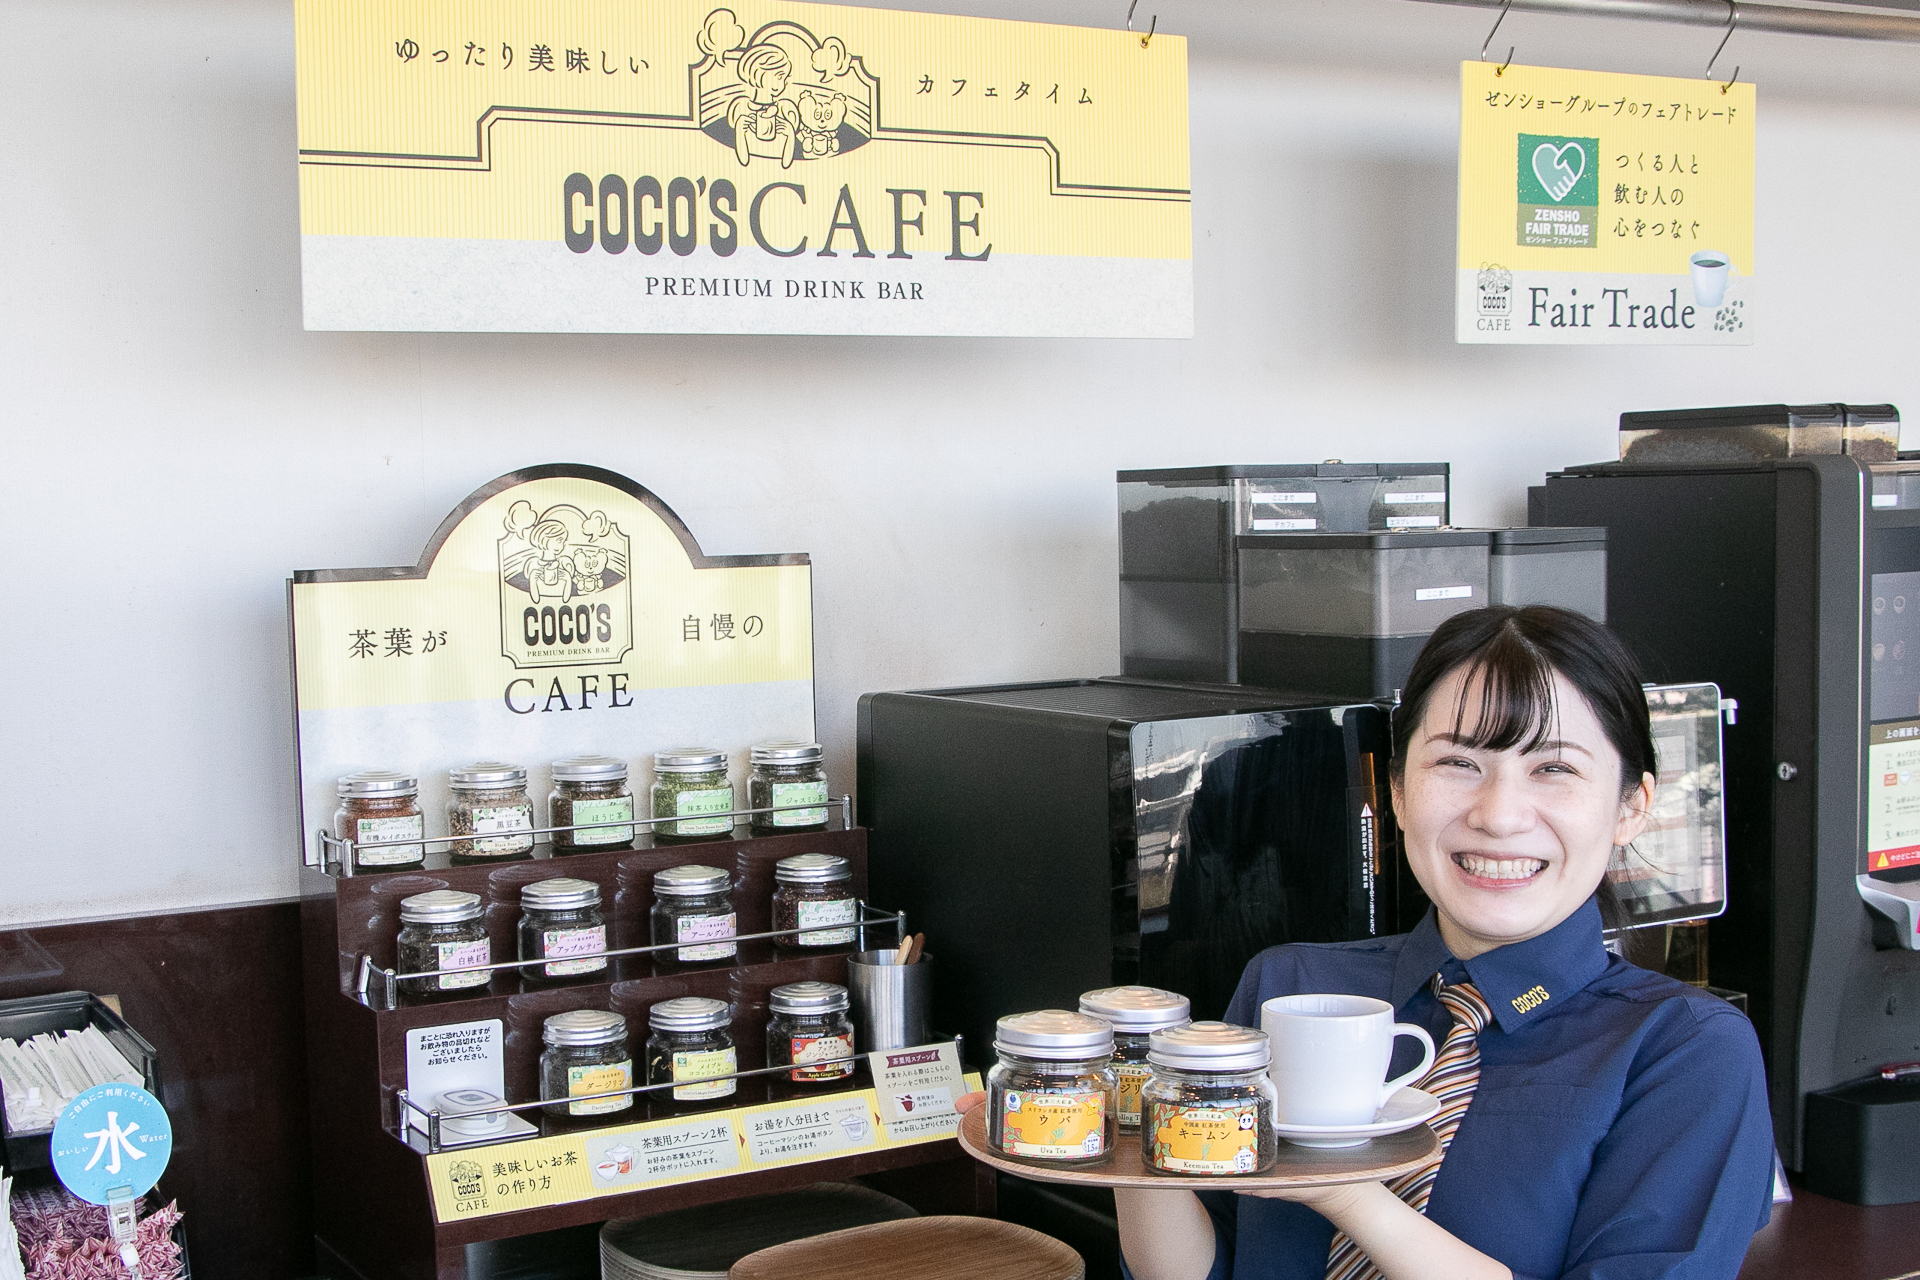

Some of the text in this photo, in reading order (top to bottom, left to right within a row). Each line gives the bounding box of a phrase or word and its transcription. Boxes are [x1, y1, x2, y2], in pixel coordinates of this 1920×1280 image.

[395, 38, 650, 75] ゆったり美味しい
[916, 74, 1094, 105] カフェタイム
[1485, 91, 1737, 125] ゼンショーグループのフェアトレード
[1615, 152, 1700, 175] つくる人と
[1614, 183, 1685, 206] 飲む人の
[564, 172, 993, 262] COCO'S CAFE
[1534, 208, 1581, 223] ZENSHO
[1525, 222, 1590, 237] FAIR TRADE
[1613, 217, 1701, 240] 心をつなぐ
[1525, 236, 1589, 246] ゼンショー フェアトレード
[645, 276, 925, 301] PREMIUM DRINK BAR
[1482, 296, 1507, 309] COCO'S
[1528, 287, 1697, 329] Fair Trade
[1476, 318, 1512, 331] CAFE
[1274, 520, 1296, 528] デカフェ
[523, 602, 612, 647] COCO'S
[682, 613, 764, 642] 自慢の
[348, 627, 448, 659] 茶葉が
[527, 649, 565, 657] PREMIUM
[567, 648, 592, 656] DRINK
[504, 672, 634, 715] CAFE
[786, 794, 823, 805] ジャスミン茶
[687, 802, 729, 813] 抹茶入り玄米茶
[592, 811, 623, 822] ほうじ茶
[497, 819, 521, 830] 黒豆茶
[691, 927, 730, 940] アールグレイ
[557, 942, 602, 954] アップルティー
[458, 952, 487, 966] 白桃紅茶
[1511, 984, 1551, 1015] COCO'S
[420, 1026, 491, 1042] まことに恐れ入りますが
[420, 1035, 491, 1050] お飲み物の品切れなど
[433, 1044, 482, 1057] ございましたら
[428, 1053, 488, 1066] お知らせください。
[892, 1053, 932, 1066] 茶葉用スプーン
[884, 1064, 951, 1080] 茶葉を入れる際はこちらの
[586, 1079, 625, 1091] ダージリン
[886, 1075, 953, 1089] スプーンをご利用ください。
[1120, 1083, 1141, 1095] ジリ
[68, 1088, 151, 1120] ご自由にご利用ください
[754, 1111, 830, 1131] お湯を八分目まで
[1039, 1113, 1072, 1126] ウバ
[139, 1134, 168, 1143] Water
[641, 1126, 728, 1149] 茶葉用スプーン2杯
[757, 1129, 834, 1147] コーヒーマシンのお湯ボタン
[1179, 1128, 1231, 1140] キームン
[84, 1111, 147, 1175] 水
[759, 1141, 817, 1156] より、お湯を注ぎます。
[57, 1146, 89, 1157] おいしい
[647, 1148, 715, 1165] お好みの茶葉をスプーン
[493, 1151, 578, 1178] 美味しいお茶
[648, 1157, 718, 1174] 2杯分ポットに入れます。
[1183, 1161, 1224, 1170] Keemun Tea
[457, 1182, 481, 1196] COCO'S
[497, 1175, 551, 1196] の作り方
[455, 1198, 490, 1213] CAFE
